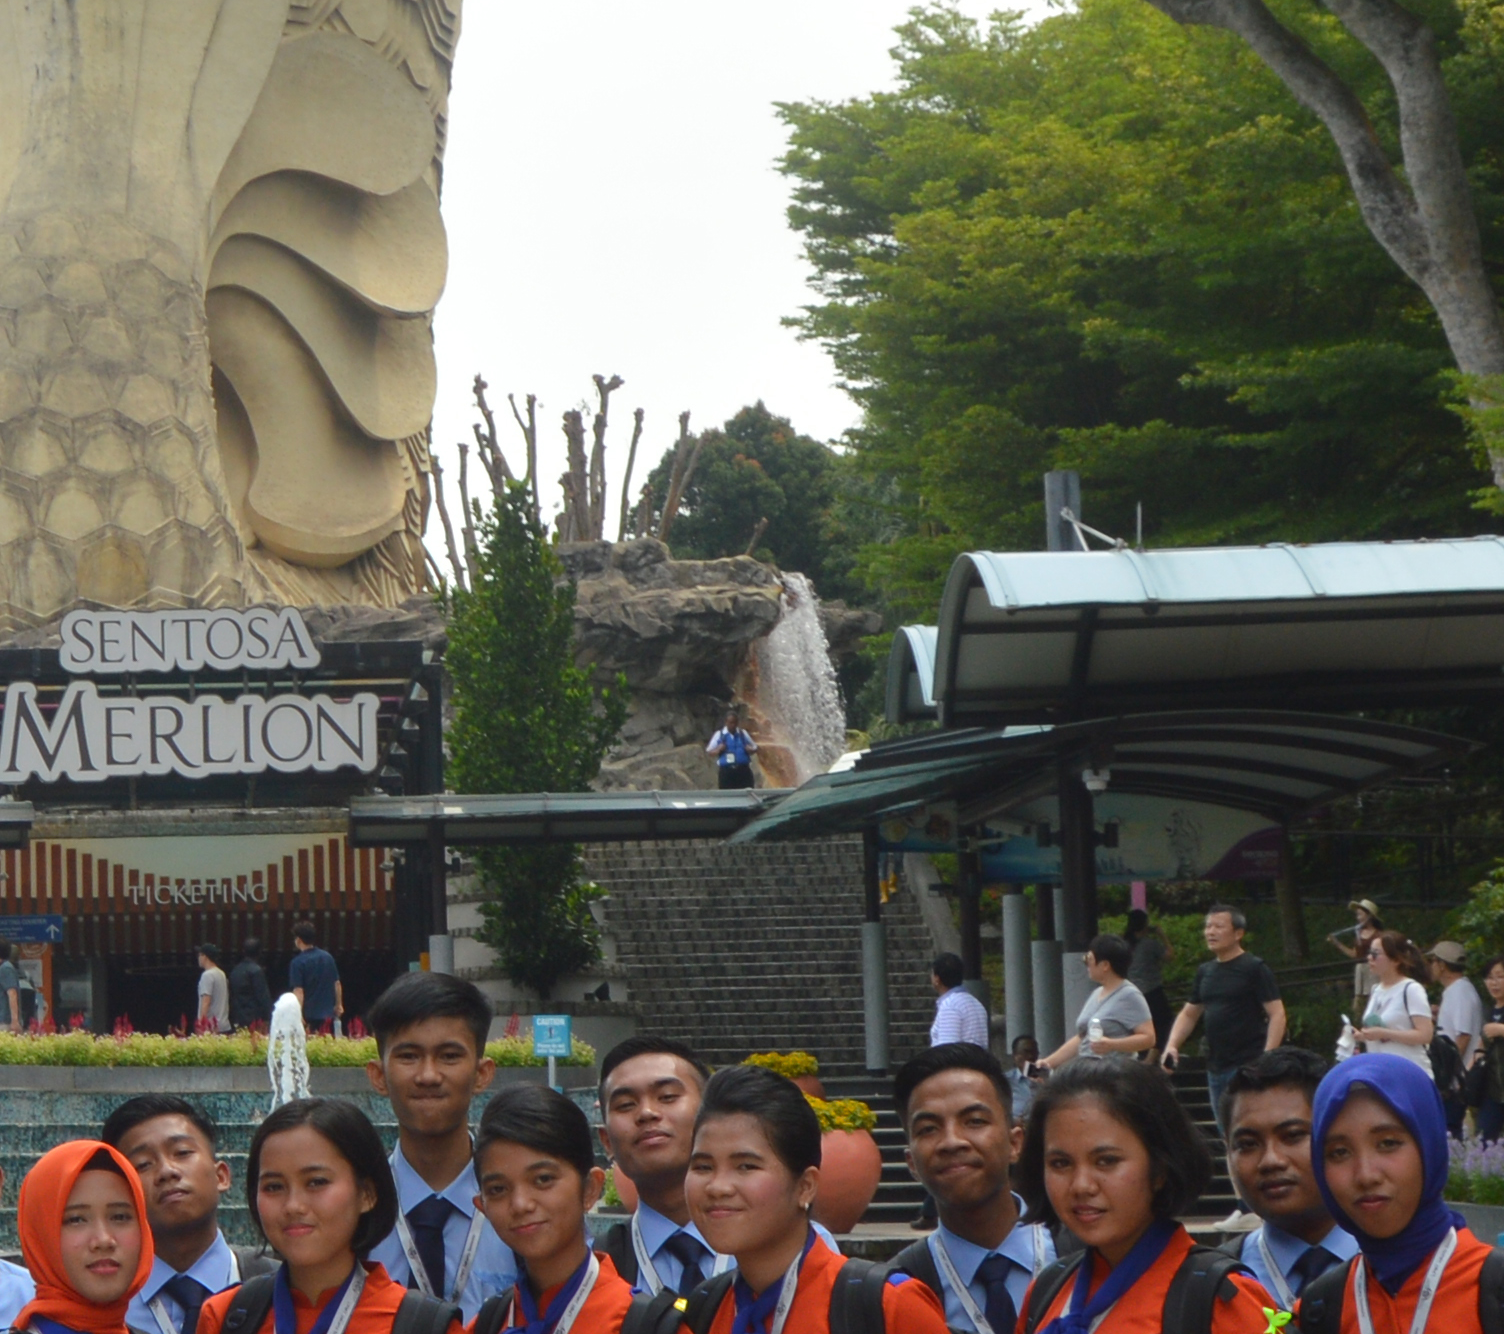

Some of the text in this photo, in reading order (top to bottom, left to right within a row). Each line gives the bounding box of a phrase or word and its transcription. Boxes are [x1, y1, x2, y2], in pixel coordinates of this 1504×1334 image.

[70, 616, 309, 664] SENTOSA
[5, 689, 365, 773] MERLION
[128, 883, 268, 906] TICKETING
